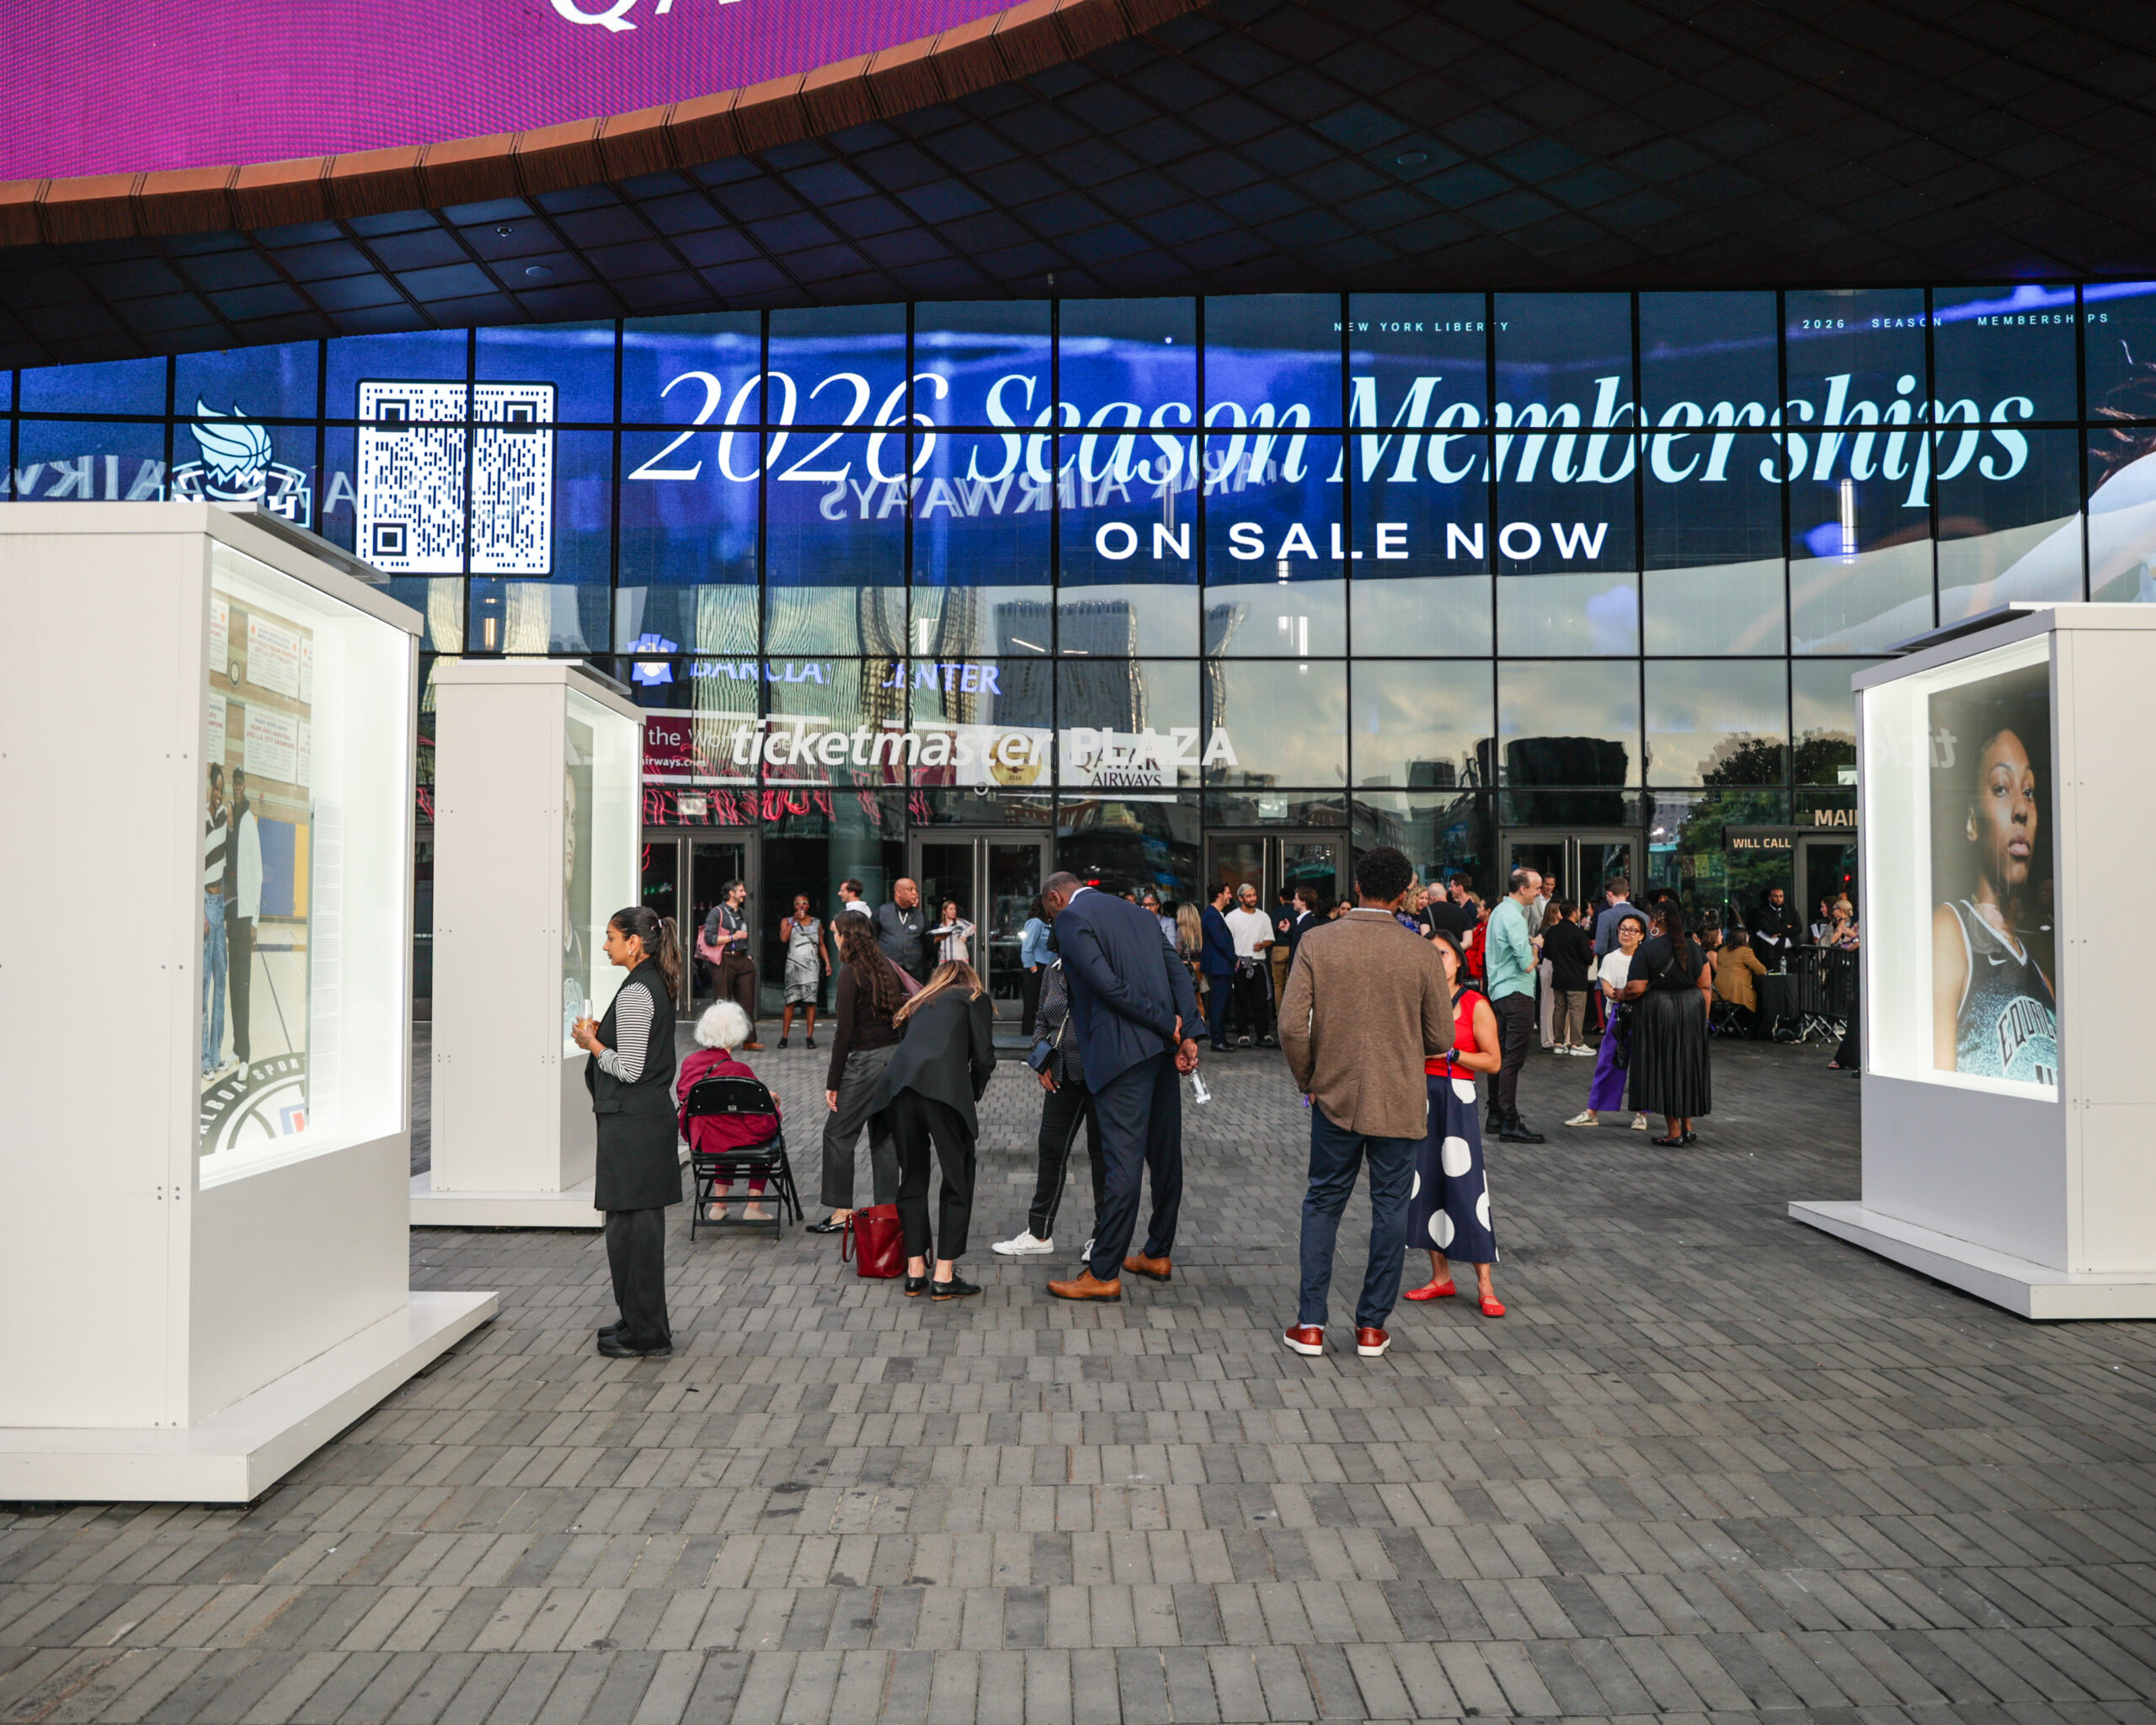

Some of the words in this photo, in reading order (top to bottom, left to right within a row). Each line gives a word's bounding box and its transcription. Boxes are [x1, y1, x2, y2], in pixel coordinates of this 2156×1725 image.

[1333, 322, 1369, 332] NEW
[1380, 322, 1424, 332] YORK
[1434, 322, 1508, 332] LIBERY
[1802, 318, 1844, 329] 2026
[1871, 318, 1942, 328] SEASON
[1977, 313, 2108, 326] MEMBERSHPS
[628, 371, 949, 483] 2026
[967, 373, 1311, 483] Season
[1326, 373, 2035, 508] Memberships
[1095, 521, 1189, 560] ON
[1228, 521, 1409, 560] SALE
[1446, 521, 1609, 560] NOW
[882, 663, 1002, 696] ENTER
[648, 726, 681, 746] the
[730, 718, 1054, 766] ticketmaster
[1070, 726, 1239, 766] PLAZA
[643, 757, 707, 769] irways.cm
[1091, 771, 1162, 787] AIRWAYS
[1733, 838, 1761, 849] WILL
[1763, 837, 1792, 848] CALL
[200, 1080, 248, 1146] ALBOA
[252, 1057, 306, 1081] SPOR
